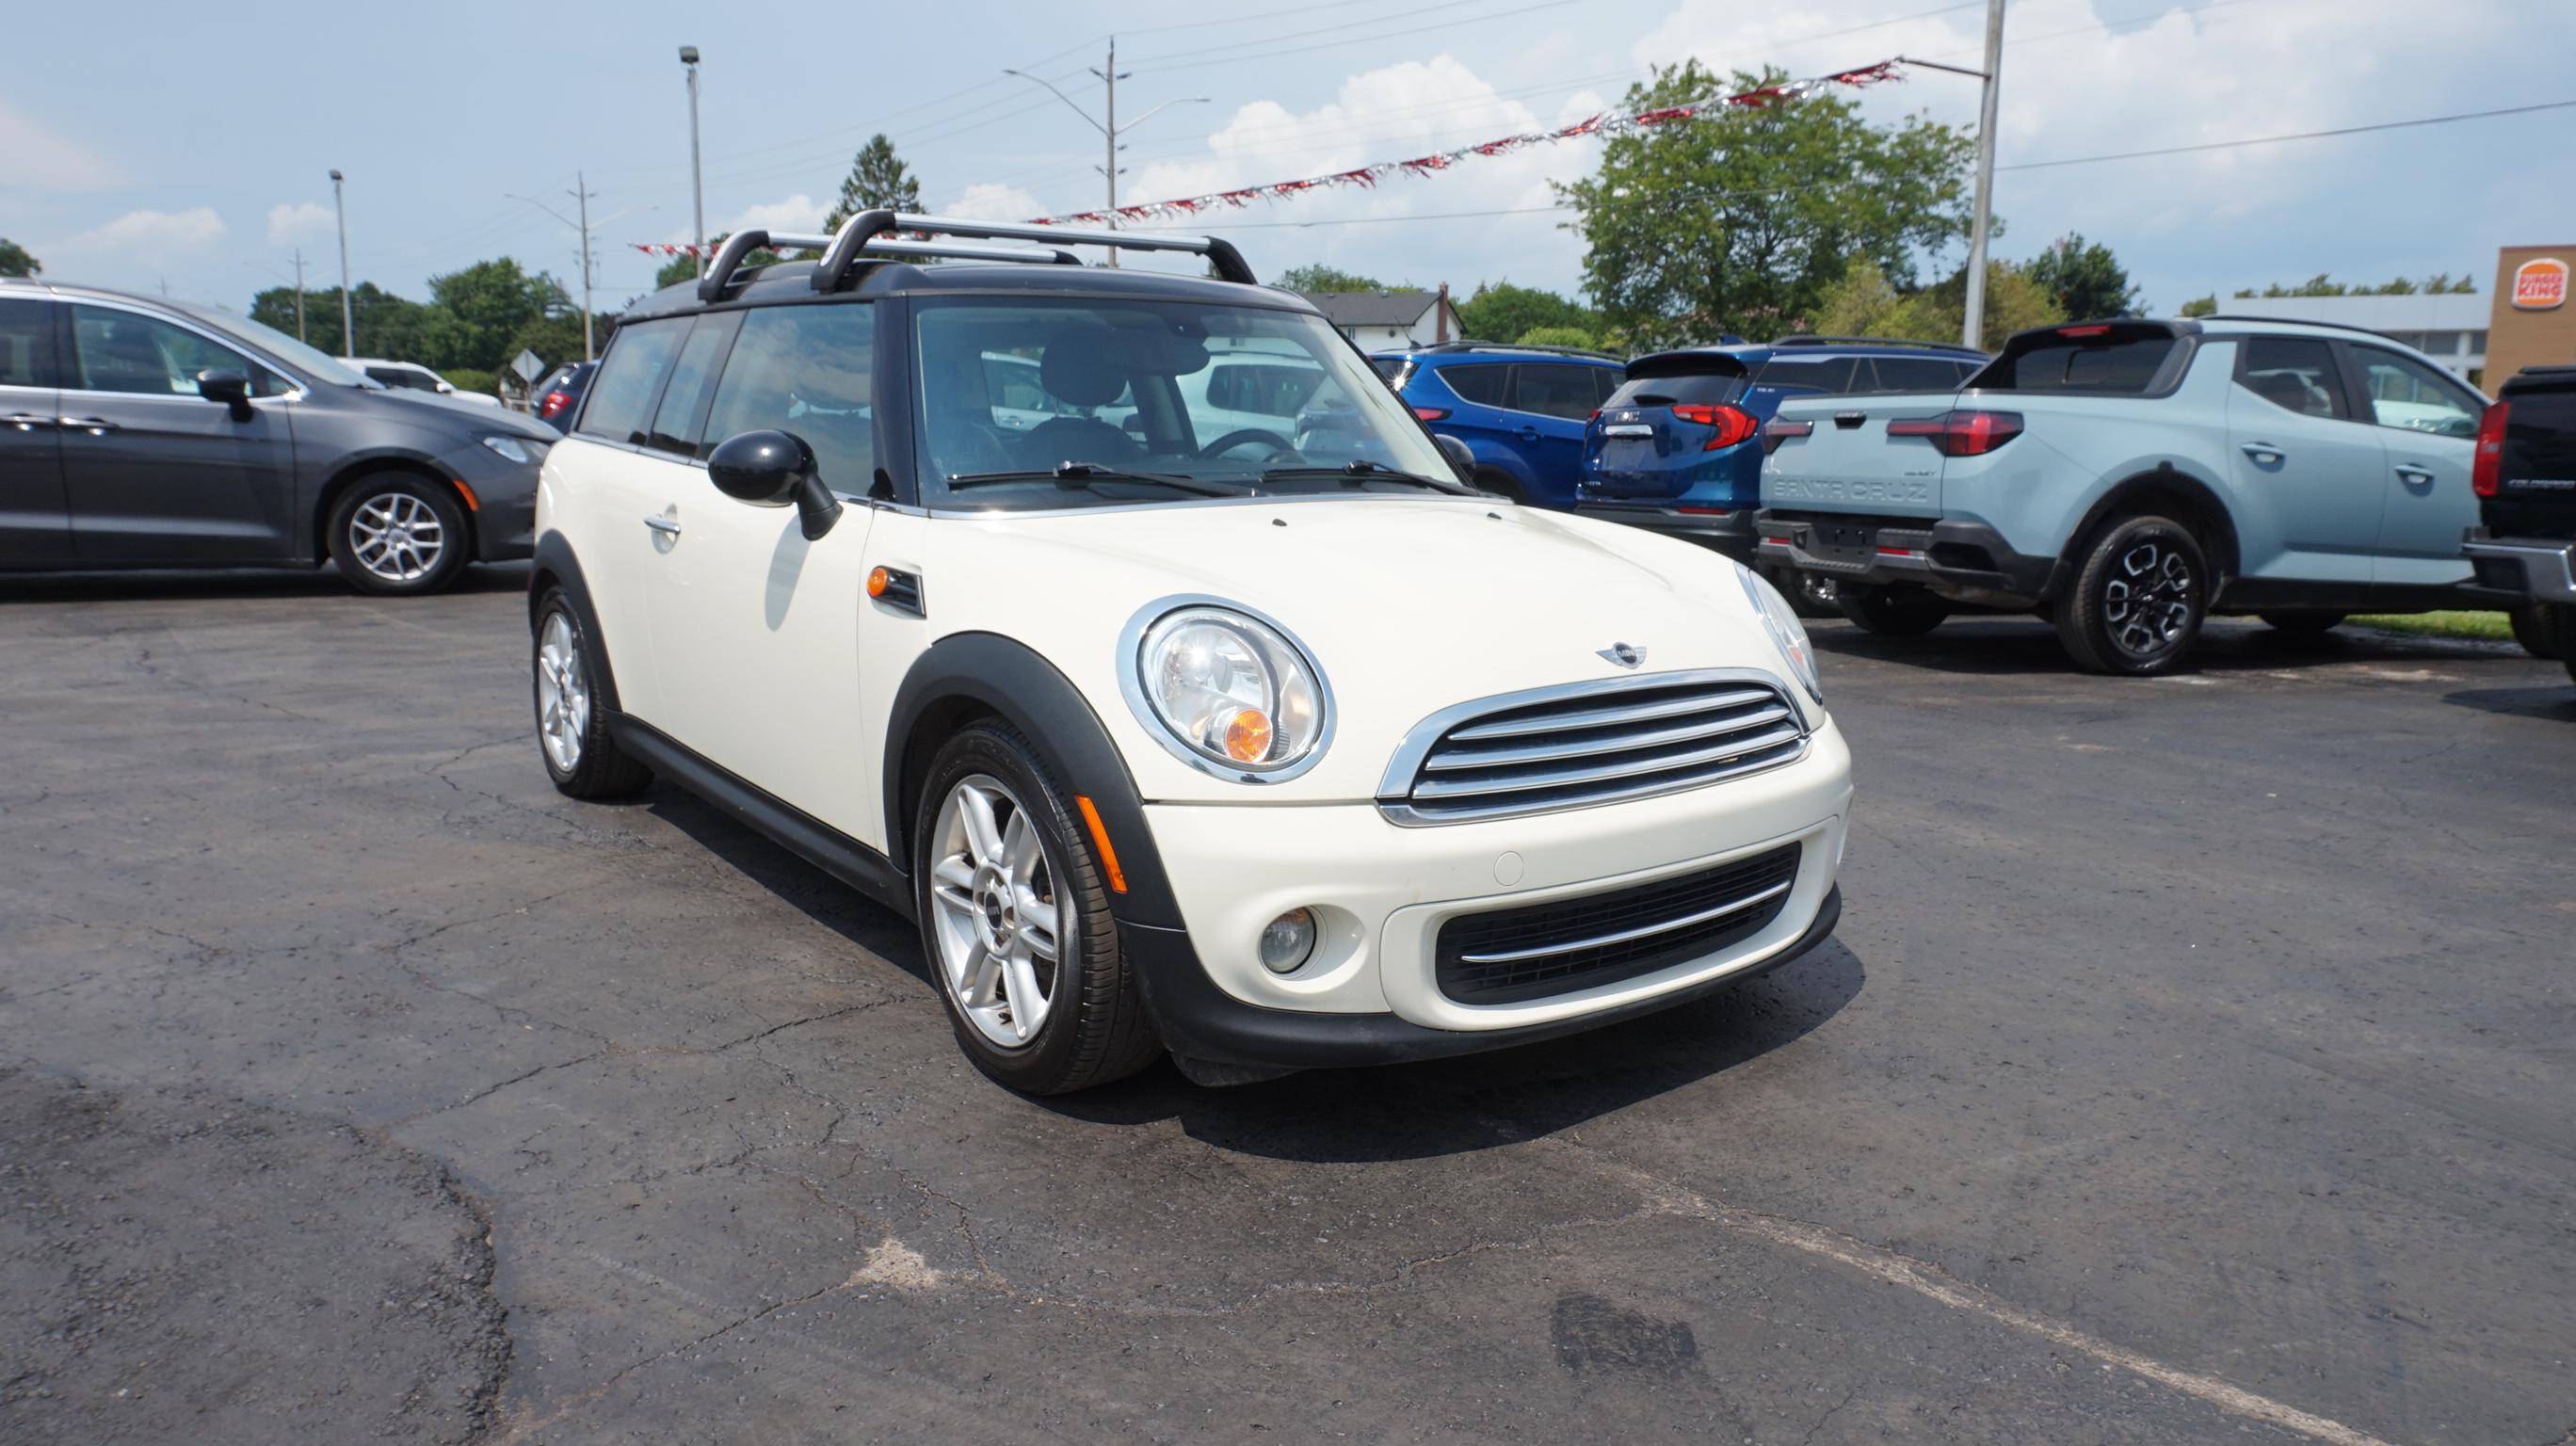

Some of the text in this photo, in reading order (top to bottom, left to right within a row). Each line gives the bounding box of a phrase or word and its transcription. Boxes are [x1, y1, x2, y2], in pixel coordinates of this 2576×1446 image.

[2518, 283, 2561, 297] KING
[1774, 478, 1929, 504] SANTA CRUZ
[1617, 649, 1637, 658] MINI
